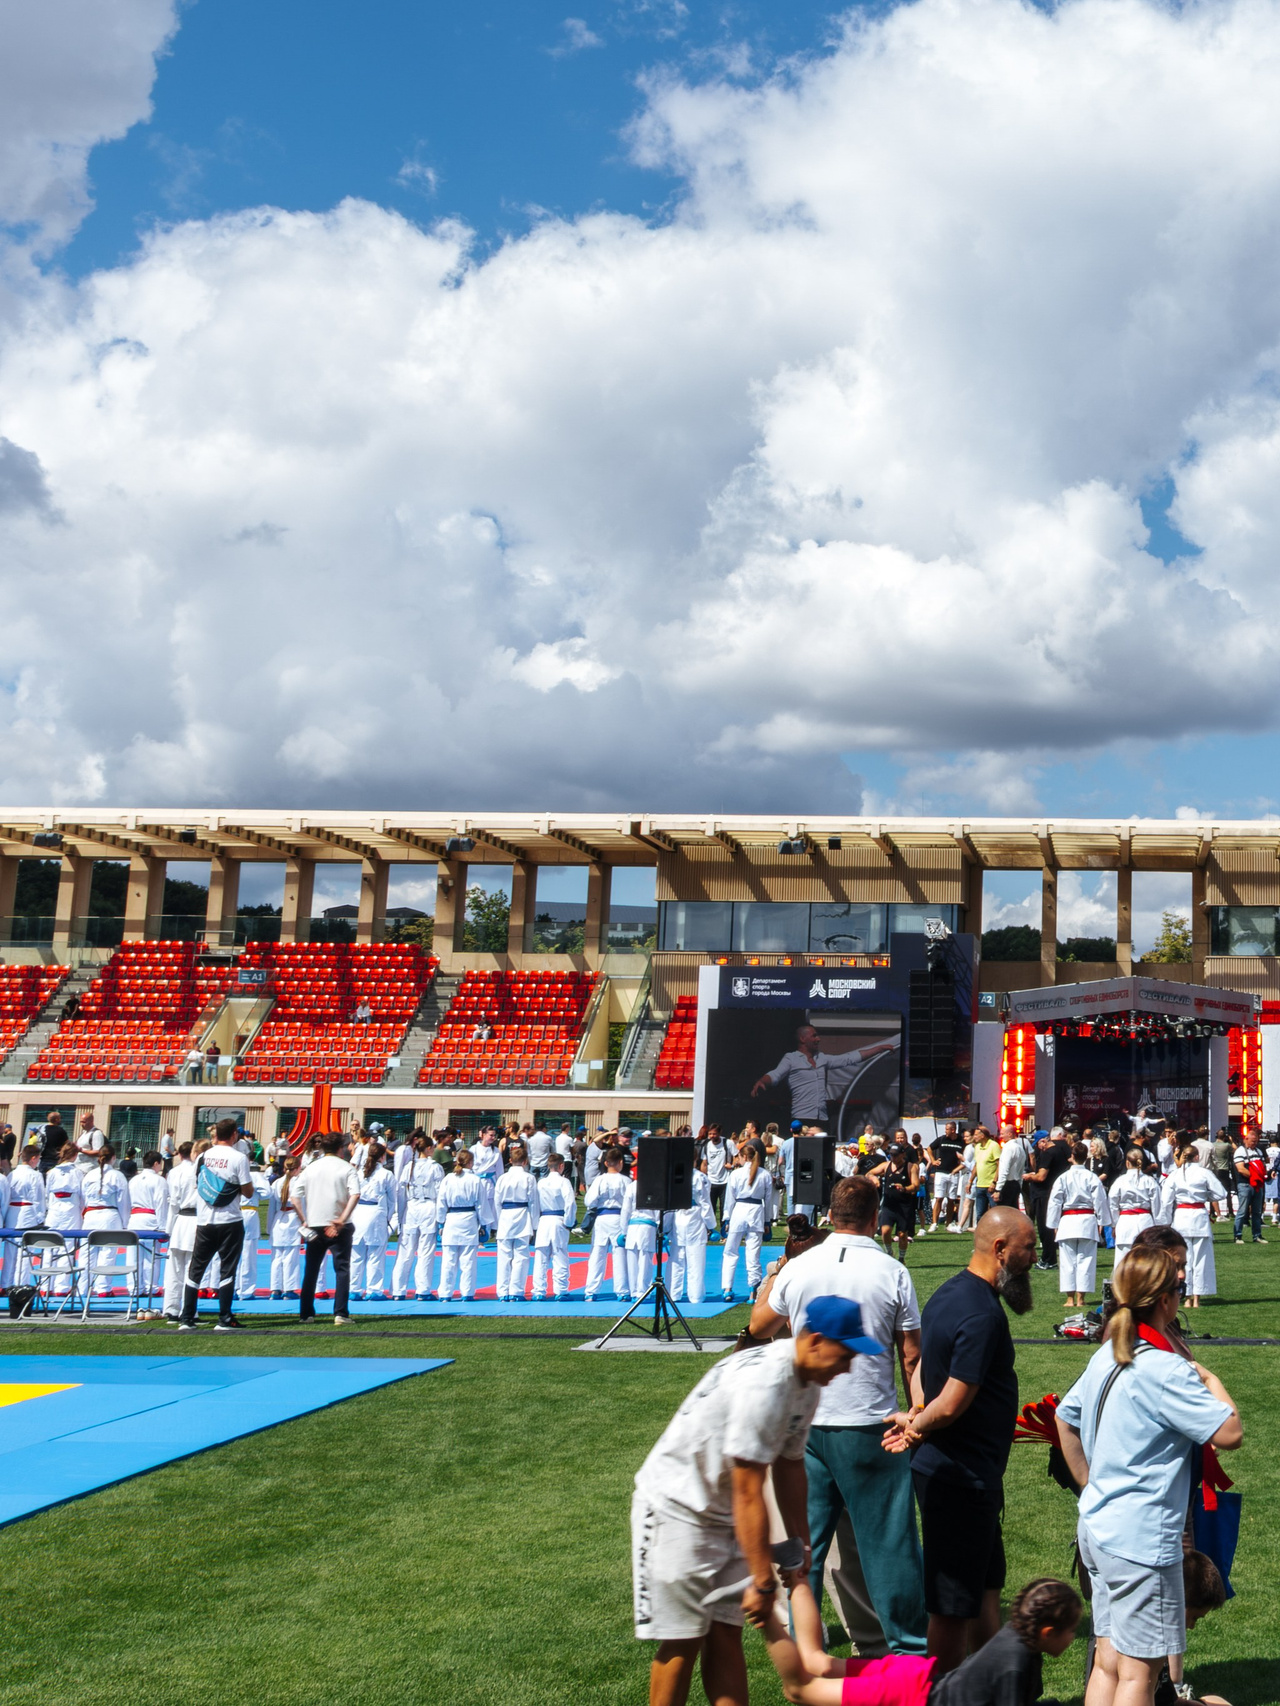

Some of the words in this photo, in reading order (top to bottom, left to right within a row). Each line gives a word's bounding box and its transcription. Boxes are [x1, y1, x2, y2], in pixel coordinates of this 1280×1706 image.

[828, 977, 876, 990] МОСКОВСКИЙ
[828, 989, 851, 999] СПОРТ
[1139, 990, 1192, 1005] ФЕСТИВАЛЬ
[1015, 998, 1067, 1012] ФЕСТИВАЛЬ
[1155, 1084, 1203, 1100] МОСКОВСКИЙ
[1156, 1101, 1178, 1113] СПОРТ
